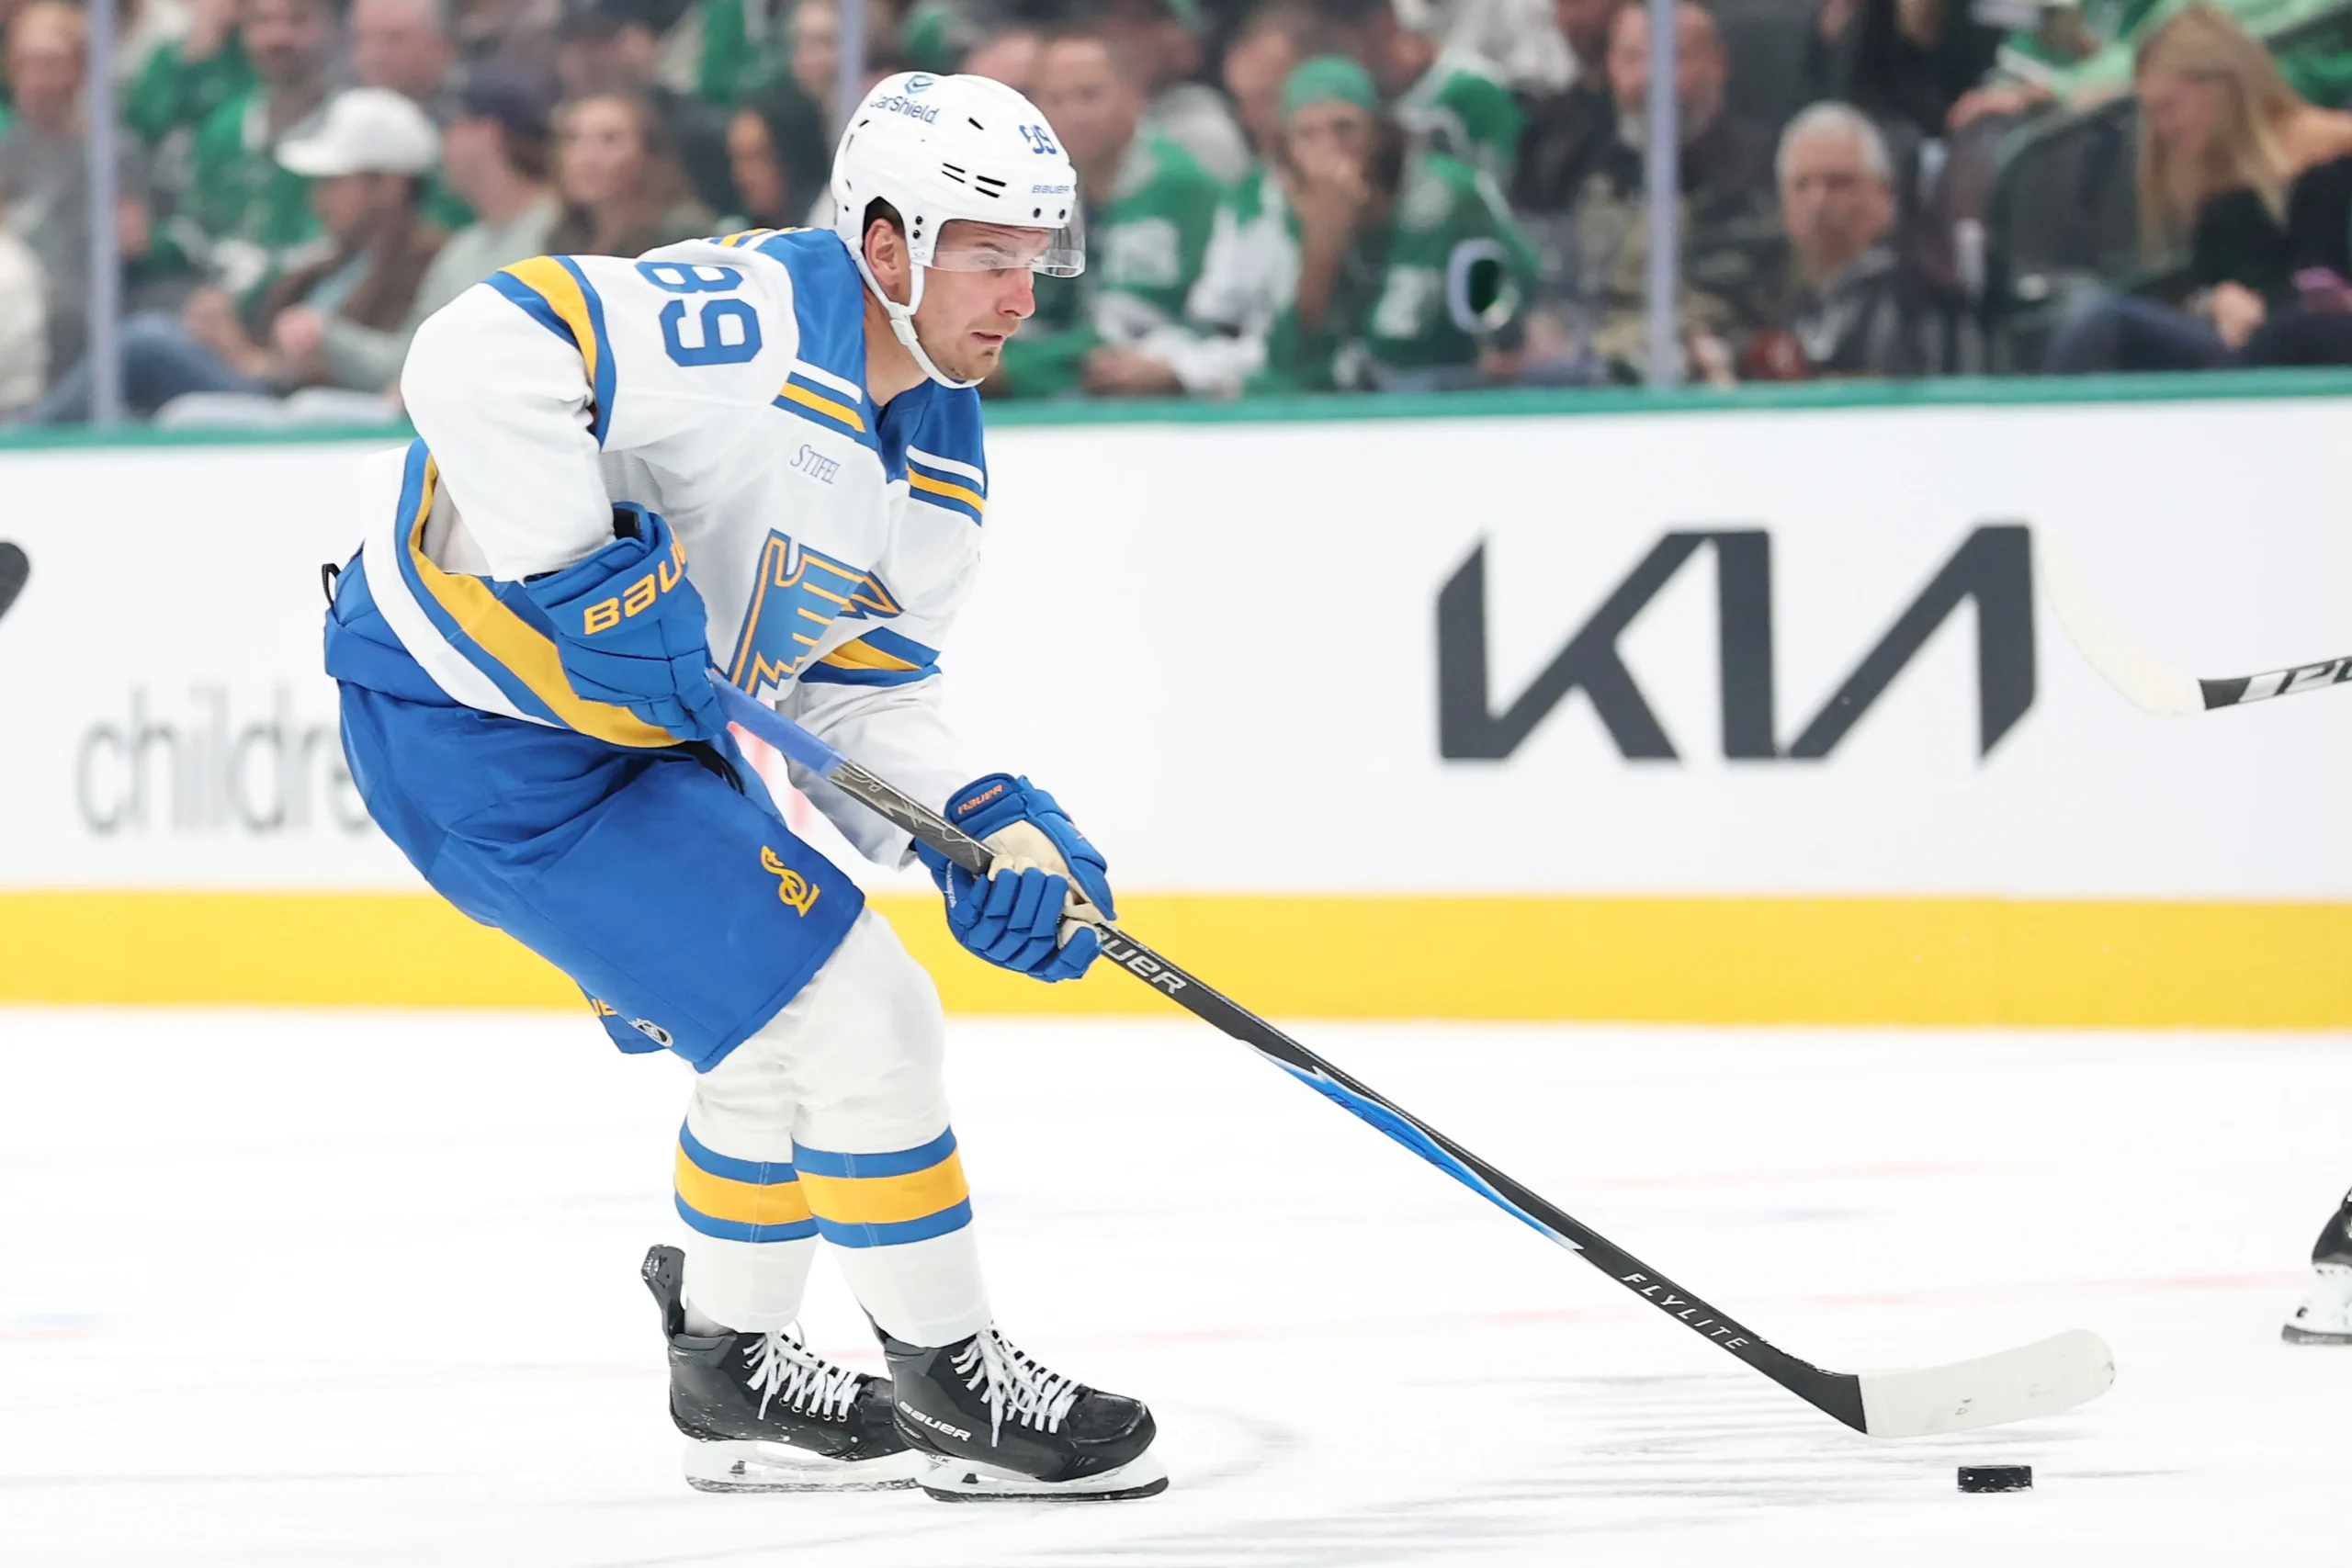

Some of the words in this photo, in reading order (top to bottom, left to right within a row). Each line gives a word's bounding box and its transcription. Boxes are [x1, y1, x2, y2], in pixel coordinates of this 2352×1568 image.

[1032, 185, 1070, 194] BAUER
[635, 261, 763, 367] 89
[1437, 524, 2036, 762] KIA
[77, 678, 369, 837] childre
[1095, 926, 1187, 995] AUER
[1621, 1272, 1749, 1349] FLYLITE
[899, 1400, 972, 1442] BAUER
